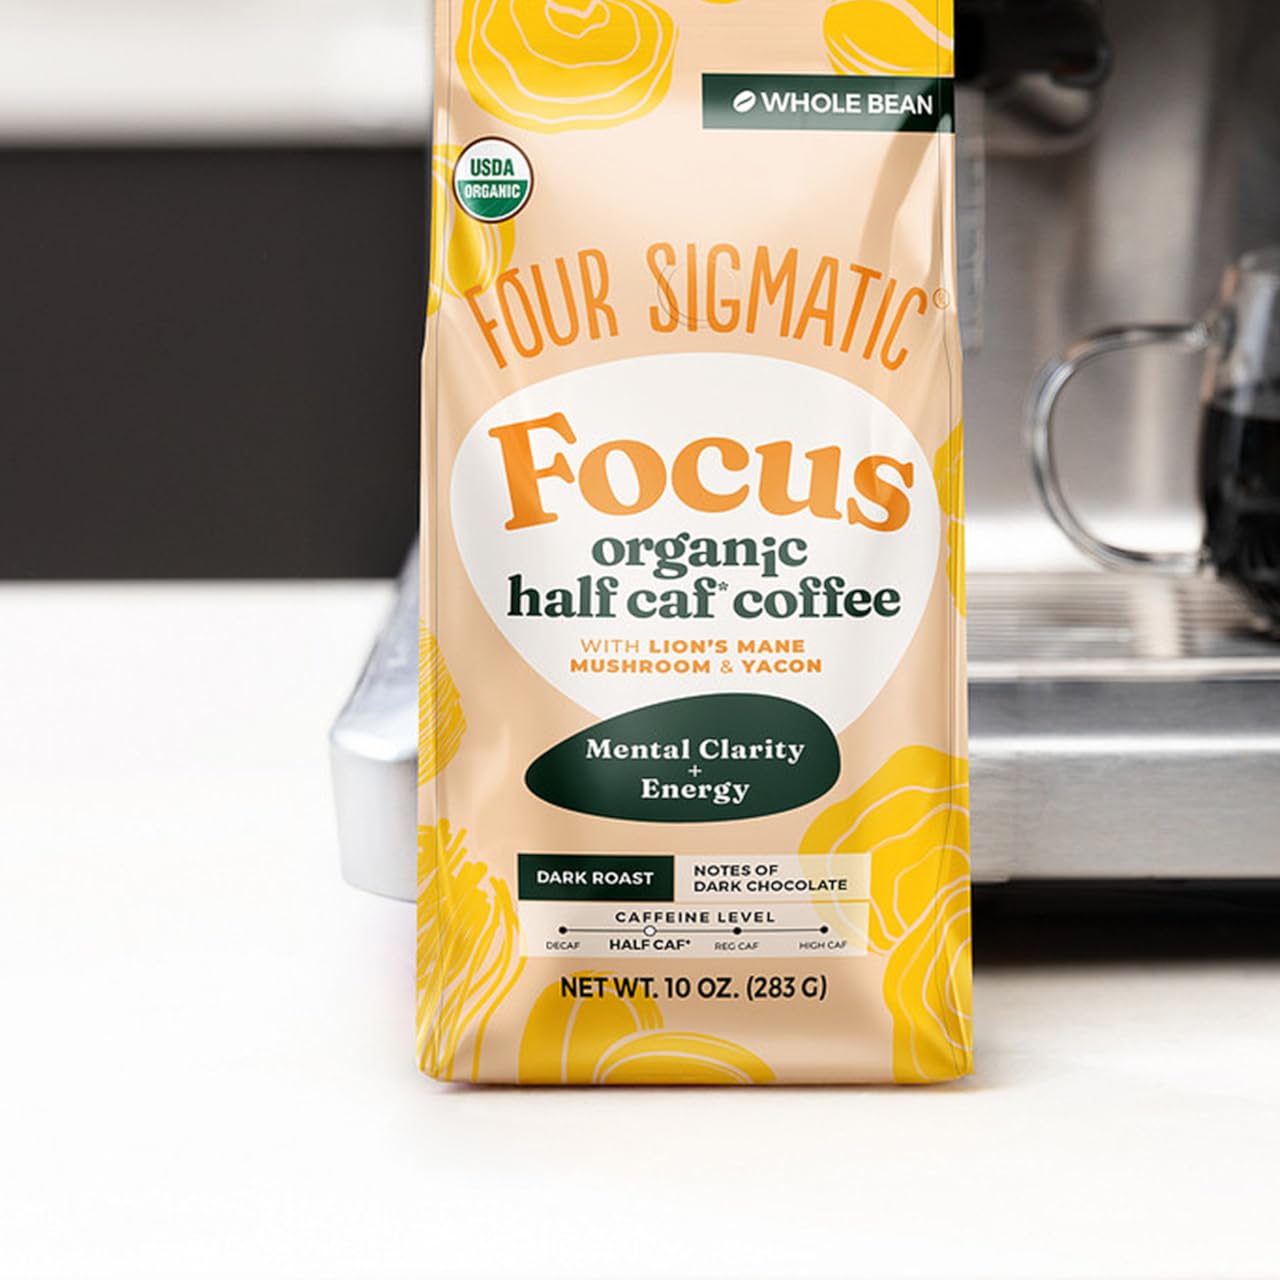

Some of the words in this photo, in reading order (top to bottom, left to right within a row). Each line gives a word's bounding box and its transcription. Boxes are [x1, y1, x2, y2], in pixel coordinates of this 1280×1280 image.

[761, 90, 862, 114] WHOLE
[869, 92, 933, 116] BEAN
[470, 157, 515, 177] USDA
[463, 183, 521, 201] ORGANIC
[464, 248, 619, 370] FOUR
[488, 412, 915, 532] Focus
[591, 532, 808, 580] organic
[507, 574, 618, 618] half
[732, 577, 901, 618] coffee
[580, 639, 641, 654] WITH
[648, 639, 728, 654] LION'S
[738, 639, 805, 654] MANE
[570, 659, 711, 673] MUSHROOM
[720, 659, 734, 673] &
[742, 659, 822, 673] YACON
[586, 739, 691, 760] Mental
[699, 738, 806, 764] Clarity
[640, 778, 750, 804] Energy
[536, 870, 587, 885] DARK
[592, 871, 655, 885] ROAST
[694, 865, 748, 877] NOTES
[755, 865, 778, 876] OF
[694, 880, 742, 892] DARK
[748, 878, 848, 892] CHOCOLATE
[615, 911, 711, 924] CAFFEINE
[717, 911, 775, 924] LEVEL
[546, 941, 580, 950] DECAF
[609, 938, 651, 951] HALF
[714, 941, 735, 950] REG
[737, 941, 759, 950] CAF
[799, 941, 825, 950] HIGH
[828, 940, 847, 950] CAF
[560, 976, 611, 999] NET
[612, 976, 658, 999] WT.
[666, 976, 691, 998] 10
[699, 976, 739, 998] OZ.
[747, 975, 797, 1001] (283
[802, 975, 828, 1000] G)
